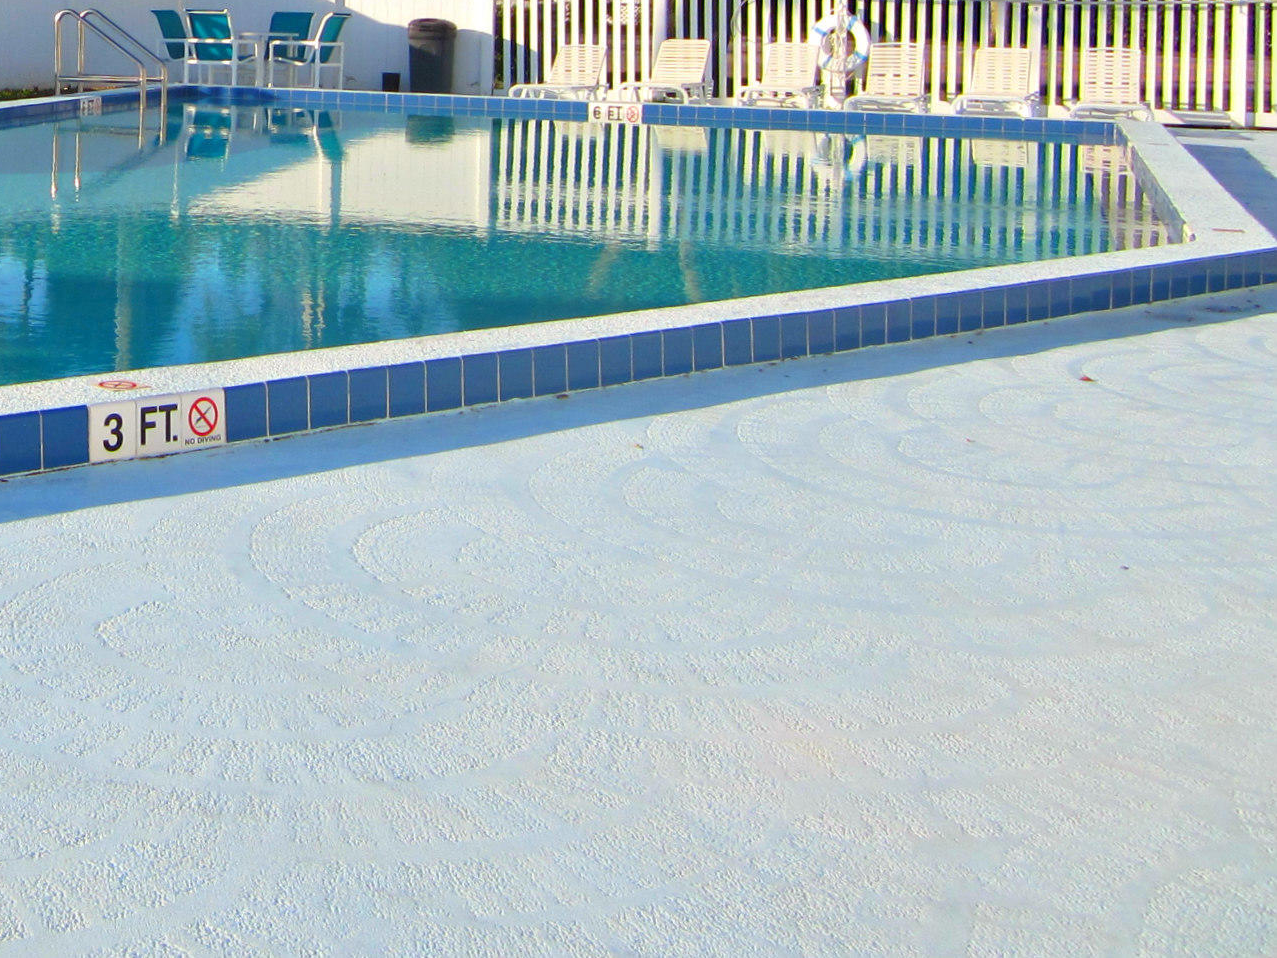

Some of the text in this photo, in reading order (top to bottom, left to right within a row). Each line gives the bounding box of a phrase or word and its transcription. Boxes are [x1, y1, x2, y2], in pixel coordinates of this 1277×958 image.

[103, 403, 178, 452] 3 FT.
[197, 434, 221, 444] DIVING
